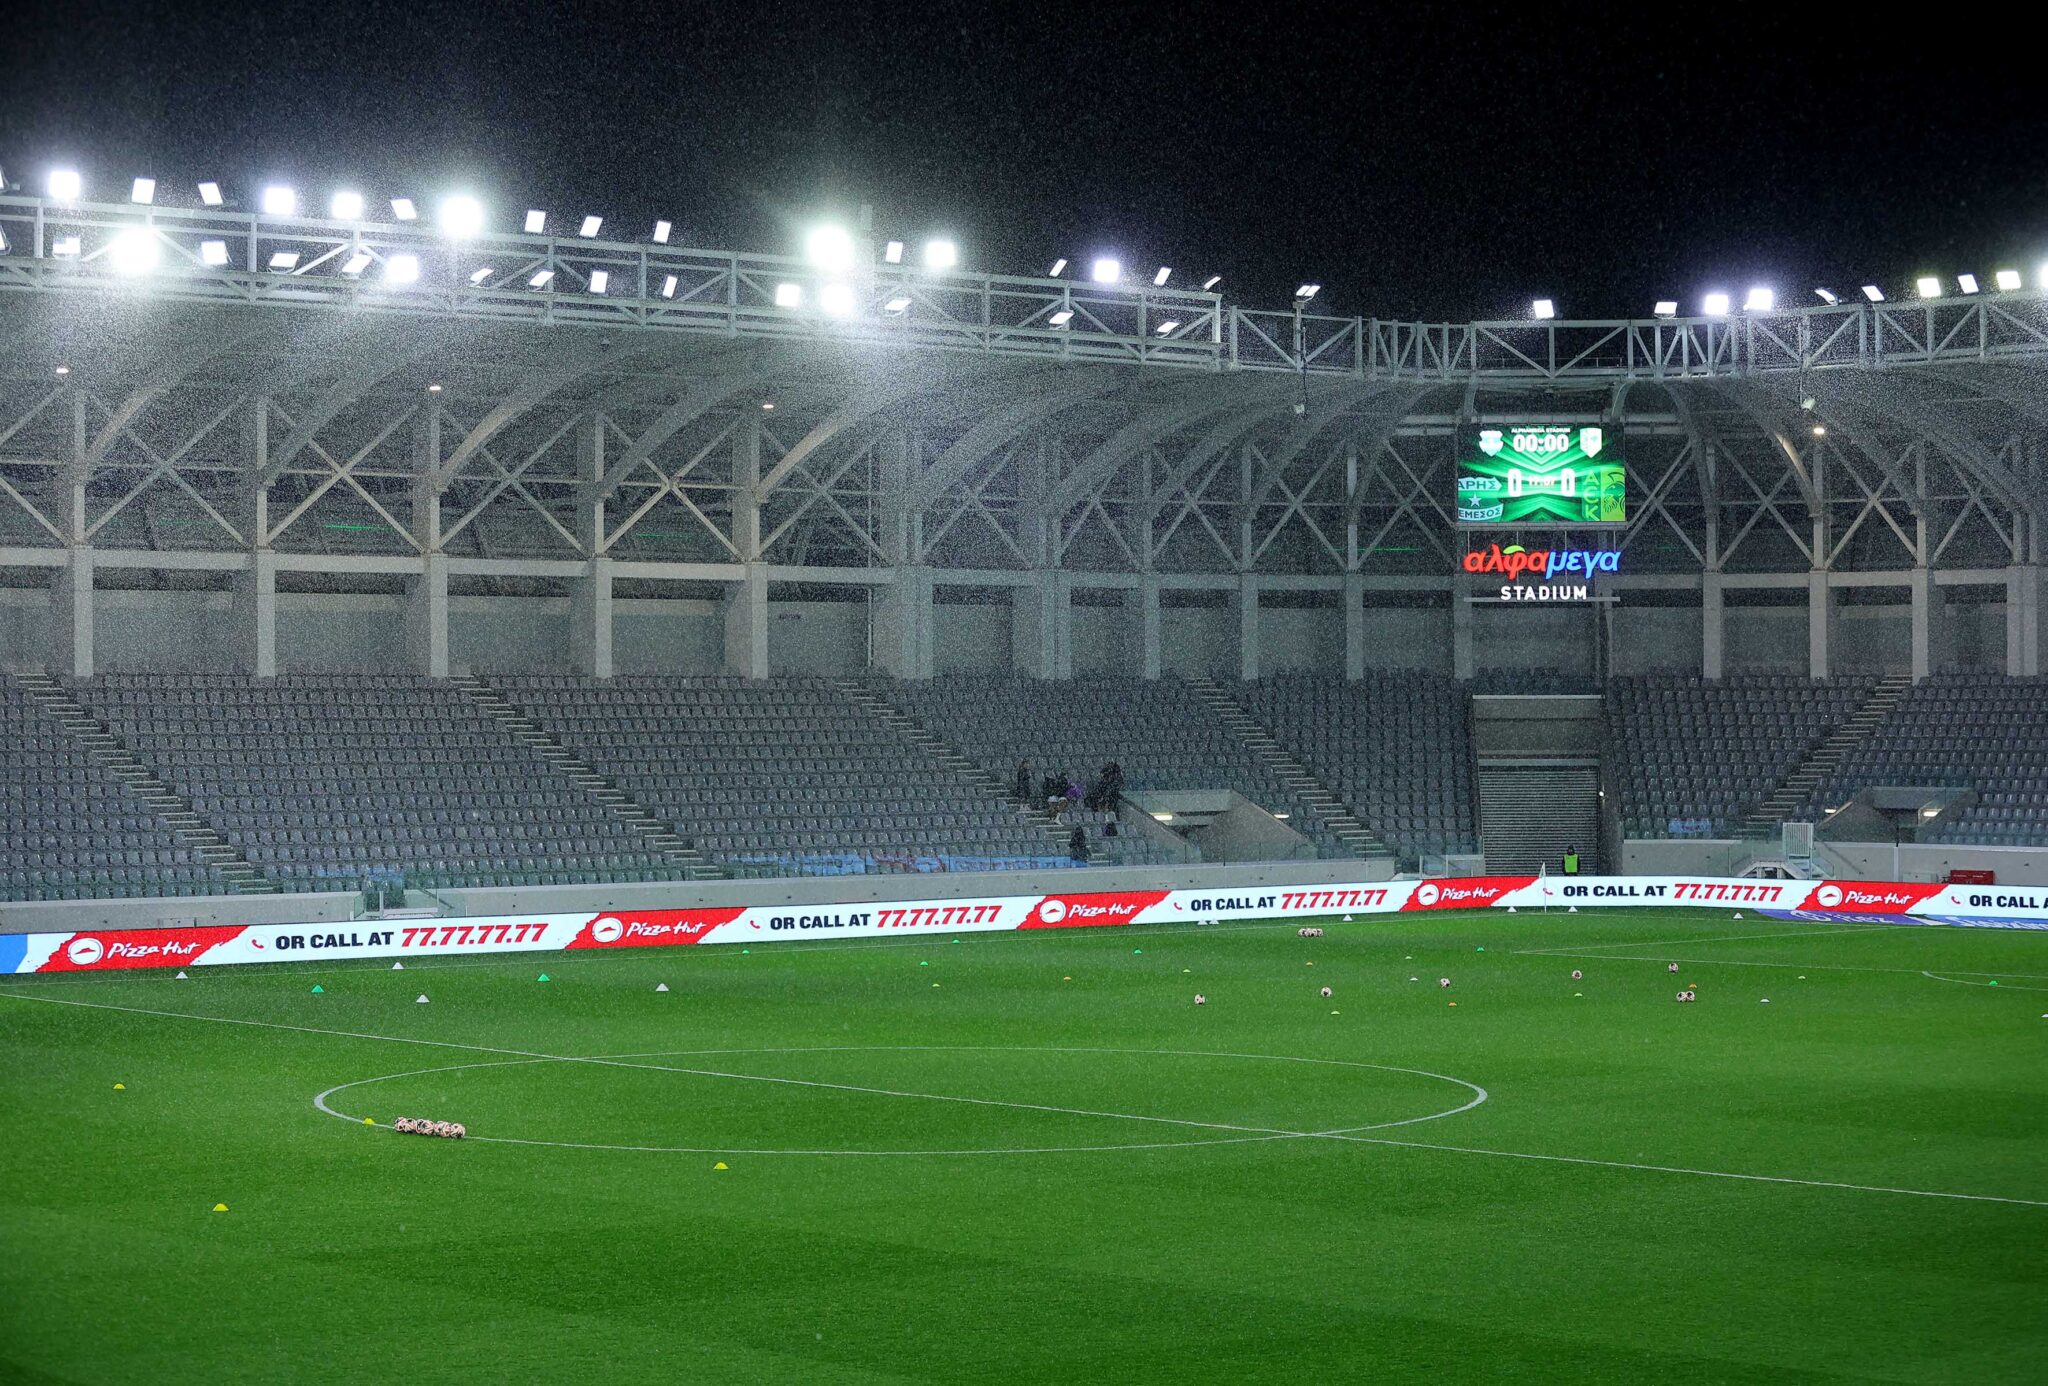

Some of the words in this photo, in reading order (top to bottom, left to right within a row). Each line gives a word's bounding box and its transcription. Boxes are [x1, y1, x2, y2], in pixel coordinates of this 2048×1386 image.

[1513, 434, 1569, 452] 00:00
[1507, 468, 1522, 497] 0
[1561, 468, 1576, 497] 0
[1500, 585, 1587, 601] STADIUM
[1190, 898, 1212, 911] OR
[1215, 897, 1254, 911] CALL
[1257, 896, 1277, 908] AT
[1282, 889, 1387, 909] 77.77.77.77
[1441, 887, 1471, 900] Pizza
[1472, 886, 1500, 898] Hut
[1563, 885, 1588, 897] OR
[1593, 885, 1642, 897] CALL
[1644, 885, 1667, 897] AT
[1675, 883, 1783, 902] 77.77.77.77
[1845, 890, 1883, 904] Pizza
[1884, 892, 1913, 905] Hut
[1969, 894, 1993, 907] OR
[1996, 895, 2040, 909] CALL
[770, 916, 795, 930] OR
[799, 914, 845, 929] CALL
[849, 913, 871, 927] AT
[878, 905, 1002, 928] 77.77.77.77
[1068, 904, 1107, 918] Pizza
[1108, 903, 1137, 916] Hut
[275, 935, 305, 950] OR
[310, 932, 363, 949] CALL
[368, 931, 394, 946] AT
[402, 923, 549, 947] 77.77.77.77
[626, 921, 671, 937] Pizza
[672, 921, 707, 935] Hut
[107, 942, 160, 959] Pizza
[161, 940, 202, 956] Hut
